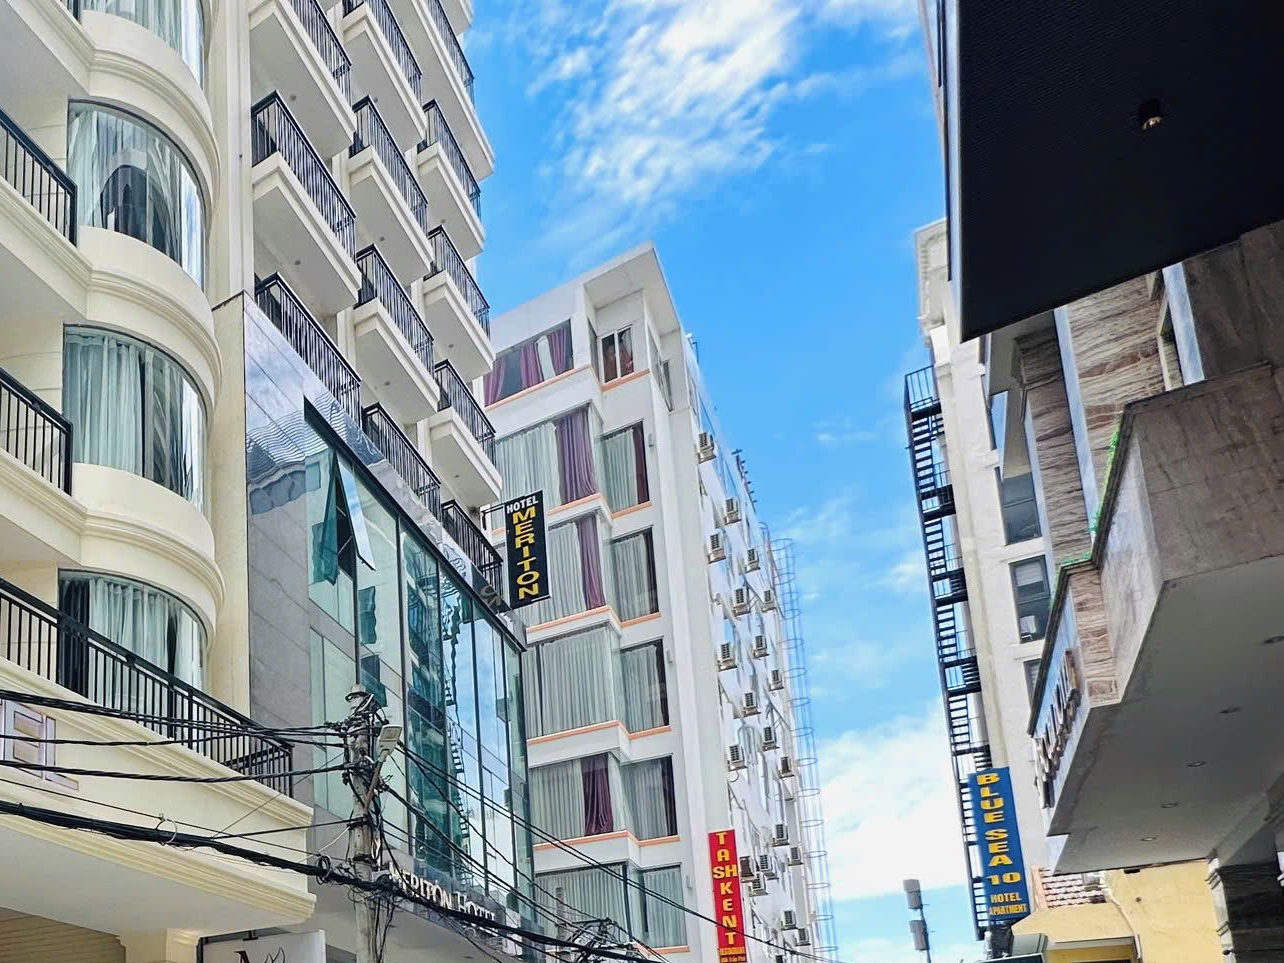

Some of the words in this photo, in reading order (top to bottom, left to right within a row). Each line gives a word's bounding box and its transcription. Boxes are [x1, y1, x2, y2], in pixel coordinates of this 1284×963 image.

[507, 496, 538, 514] HOTEL
[512, 505, 540, 600] MERITON
[976, 772, 1005, 823] BLUE
[984, 828, 1013, 867] SEA
[712, 831, 739, 945] TASHKENT
[987, 871, 1022, 886] 10
[990, 891, 1022, 903] HOTEL
